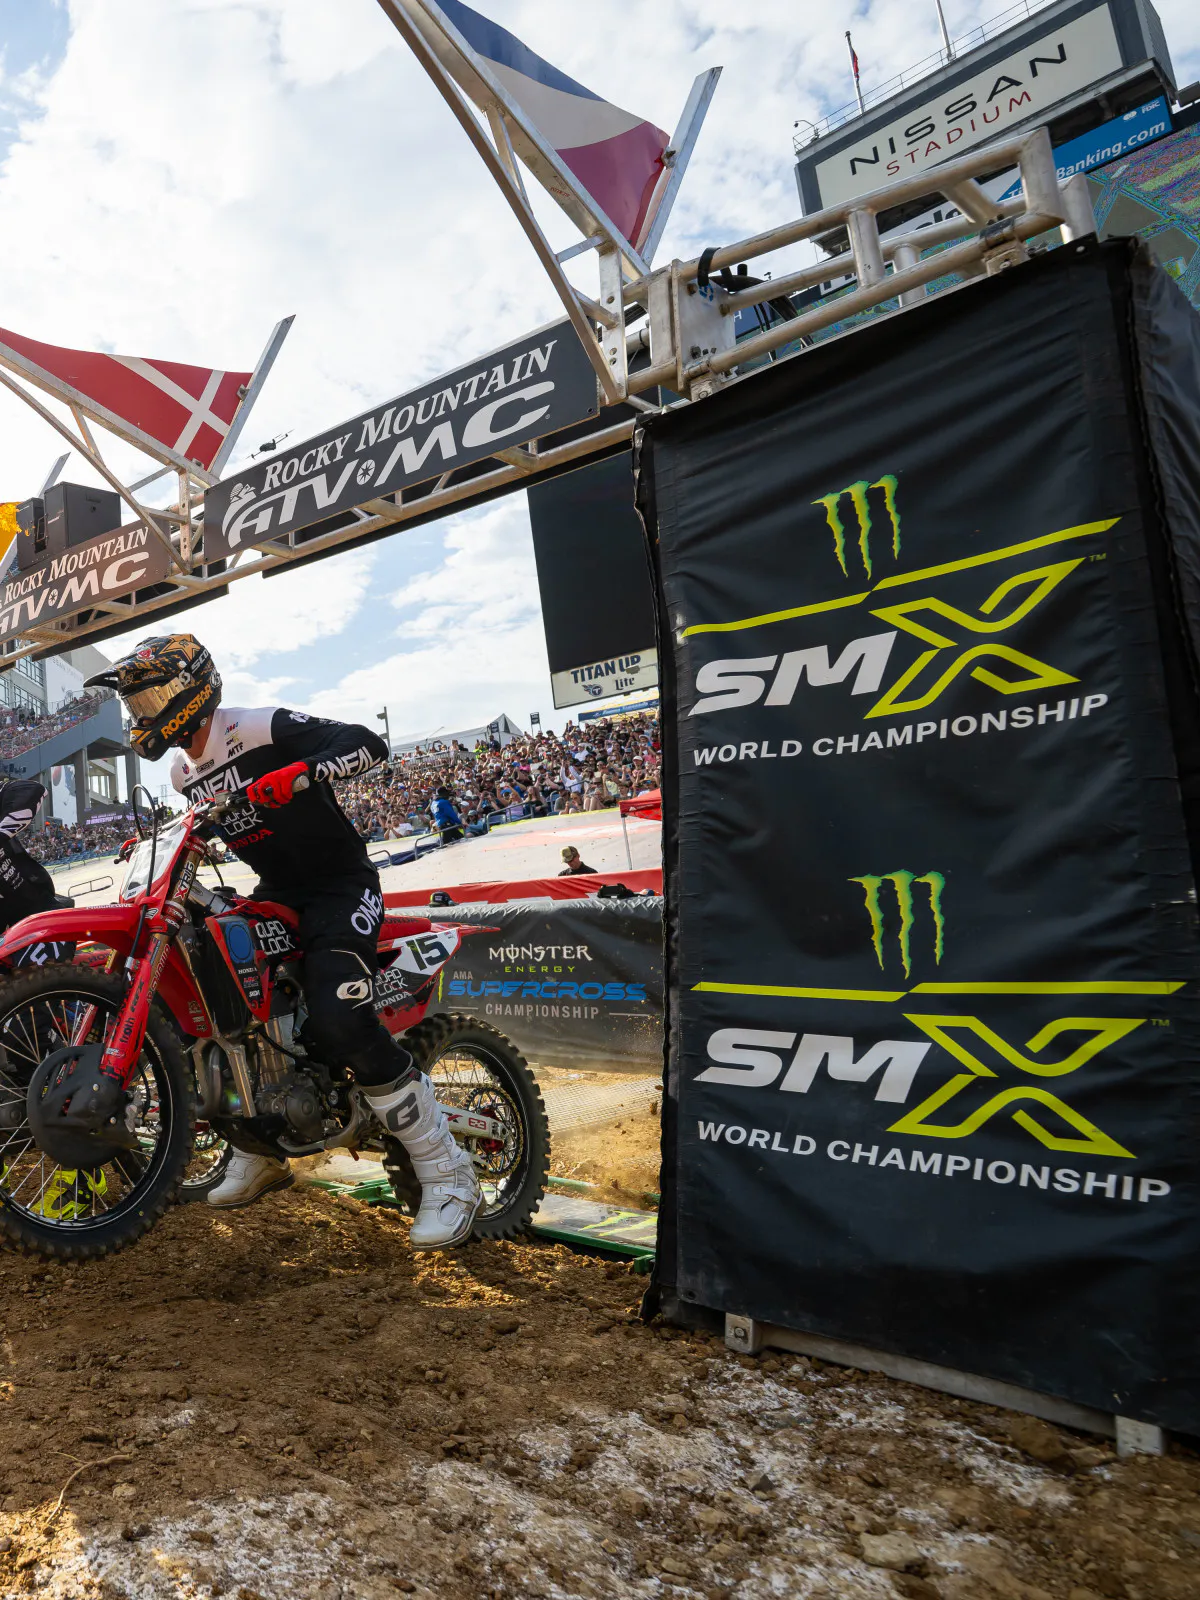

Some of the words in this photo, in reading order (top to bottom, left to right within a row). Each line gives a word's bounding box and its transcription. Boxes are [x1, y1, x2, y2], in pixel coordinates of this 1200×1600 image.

[850, 43, 1067, 176] NISSAN
[887, 90, 1032, 177] STADIUM
[261, 432, 352, 493] ROCKY
[354, 339, 558, 453] MOUNTAIN
[226, 462, 357, 549] ATV
[374, 380, 555, 488] MC
[4, 567, 46, 605] ROCKY
[48, 526, 149, 583] MOUNTAIN
[57, 551, 150, 610] MC
[687, 557, 1087, 720] SMX
[571, 660, 616, 684] TITAN
[614, 677, 635, 691] Lite
[160, 683, 214, 740] ROCKSTAR
[693, 740, 803, 766] WORLD
[812, 693, 1109, 757] CHAMPIONSHIP
[228, 741, 244, 759] MTF
[224, 812, 264, 836] LOCK
[174, 861, 195, 900] XTRIG
[255, 920, 287, 938] QUAD
[260, 934, 296, 956] LOCK
[405, 934, 451, 972] 15
[488, 942, 594, 963] MONSTER
[453, 971, 473, 980] AMA
[504, 965, 577, 973] ENERGY
[373, 991, 413, 1011] HONDA
[376, 978, 408, 996] LOCK
[447, 981, 647, 1001] SUPERCROSS
[485, 1003, 599, 1019] CHAMPIONSHIP
[693, 1013, 1148, 1159] SMX
[697, 1120, 818, 1156] WORLD
[827, 1140, 1172, 1203] CHAMPIONSHIP
